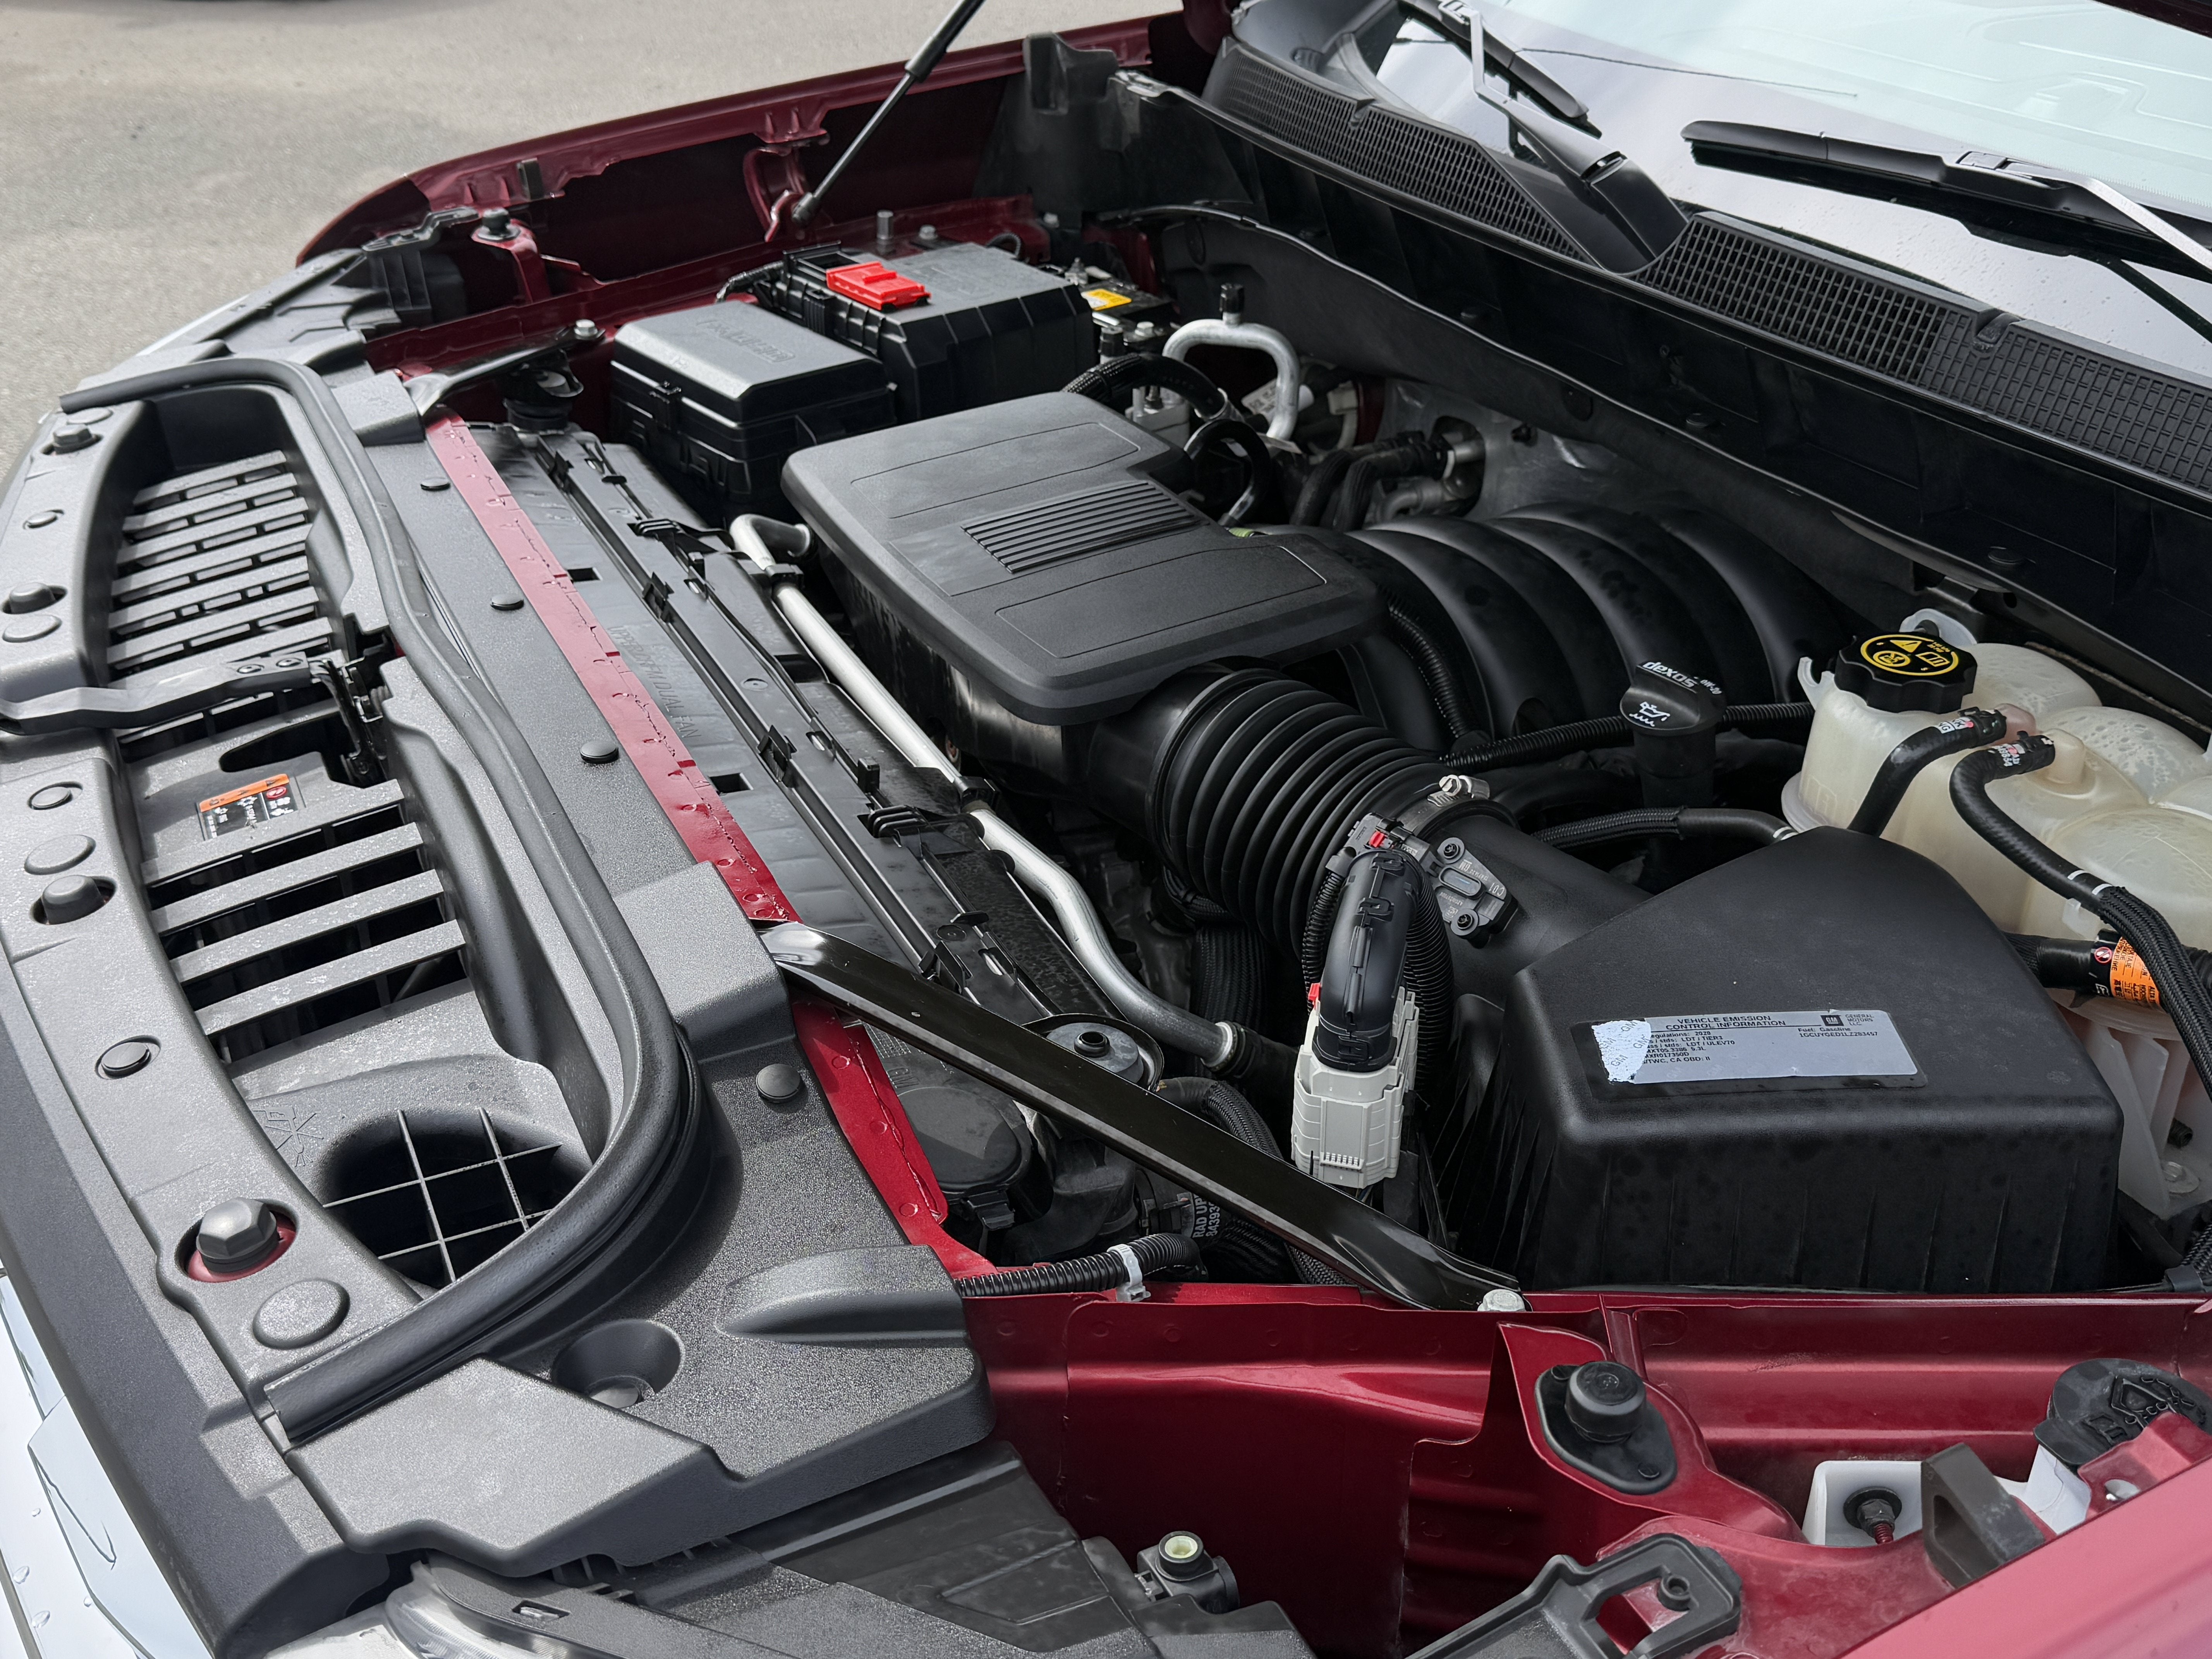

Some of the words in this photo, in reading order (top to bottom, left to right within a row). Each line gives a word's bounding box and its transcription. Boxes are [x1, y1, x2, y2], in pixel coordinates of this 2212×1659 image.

[1642, 661, 1699, 688] dexos
[1700, 679, 1722, 694] 0W-20
[653, 682, 684, 713] DUAL
[670, 716, 701, 738] FAN
[1621, 1020, 1638, 1032] GM
[1611, 1054, 1628, 1067] GM
[1192, 1217, 1207, 1238] RAD
[1206, 1201, 1220, 1237] 84393
